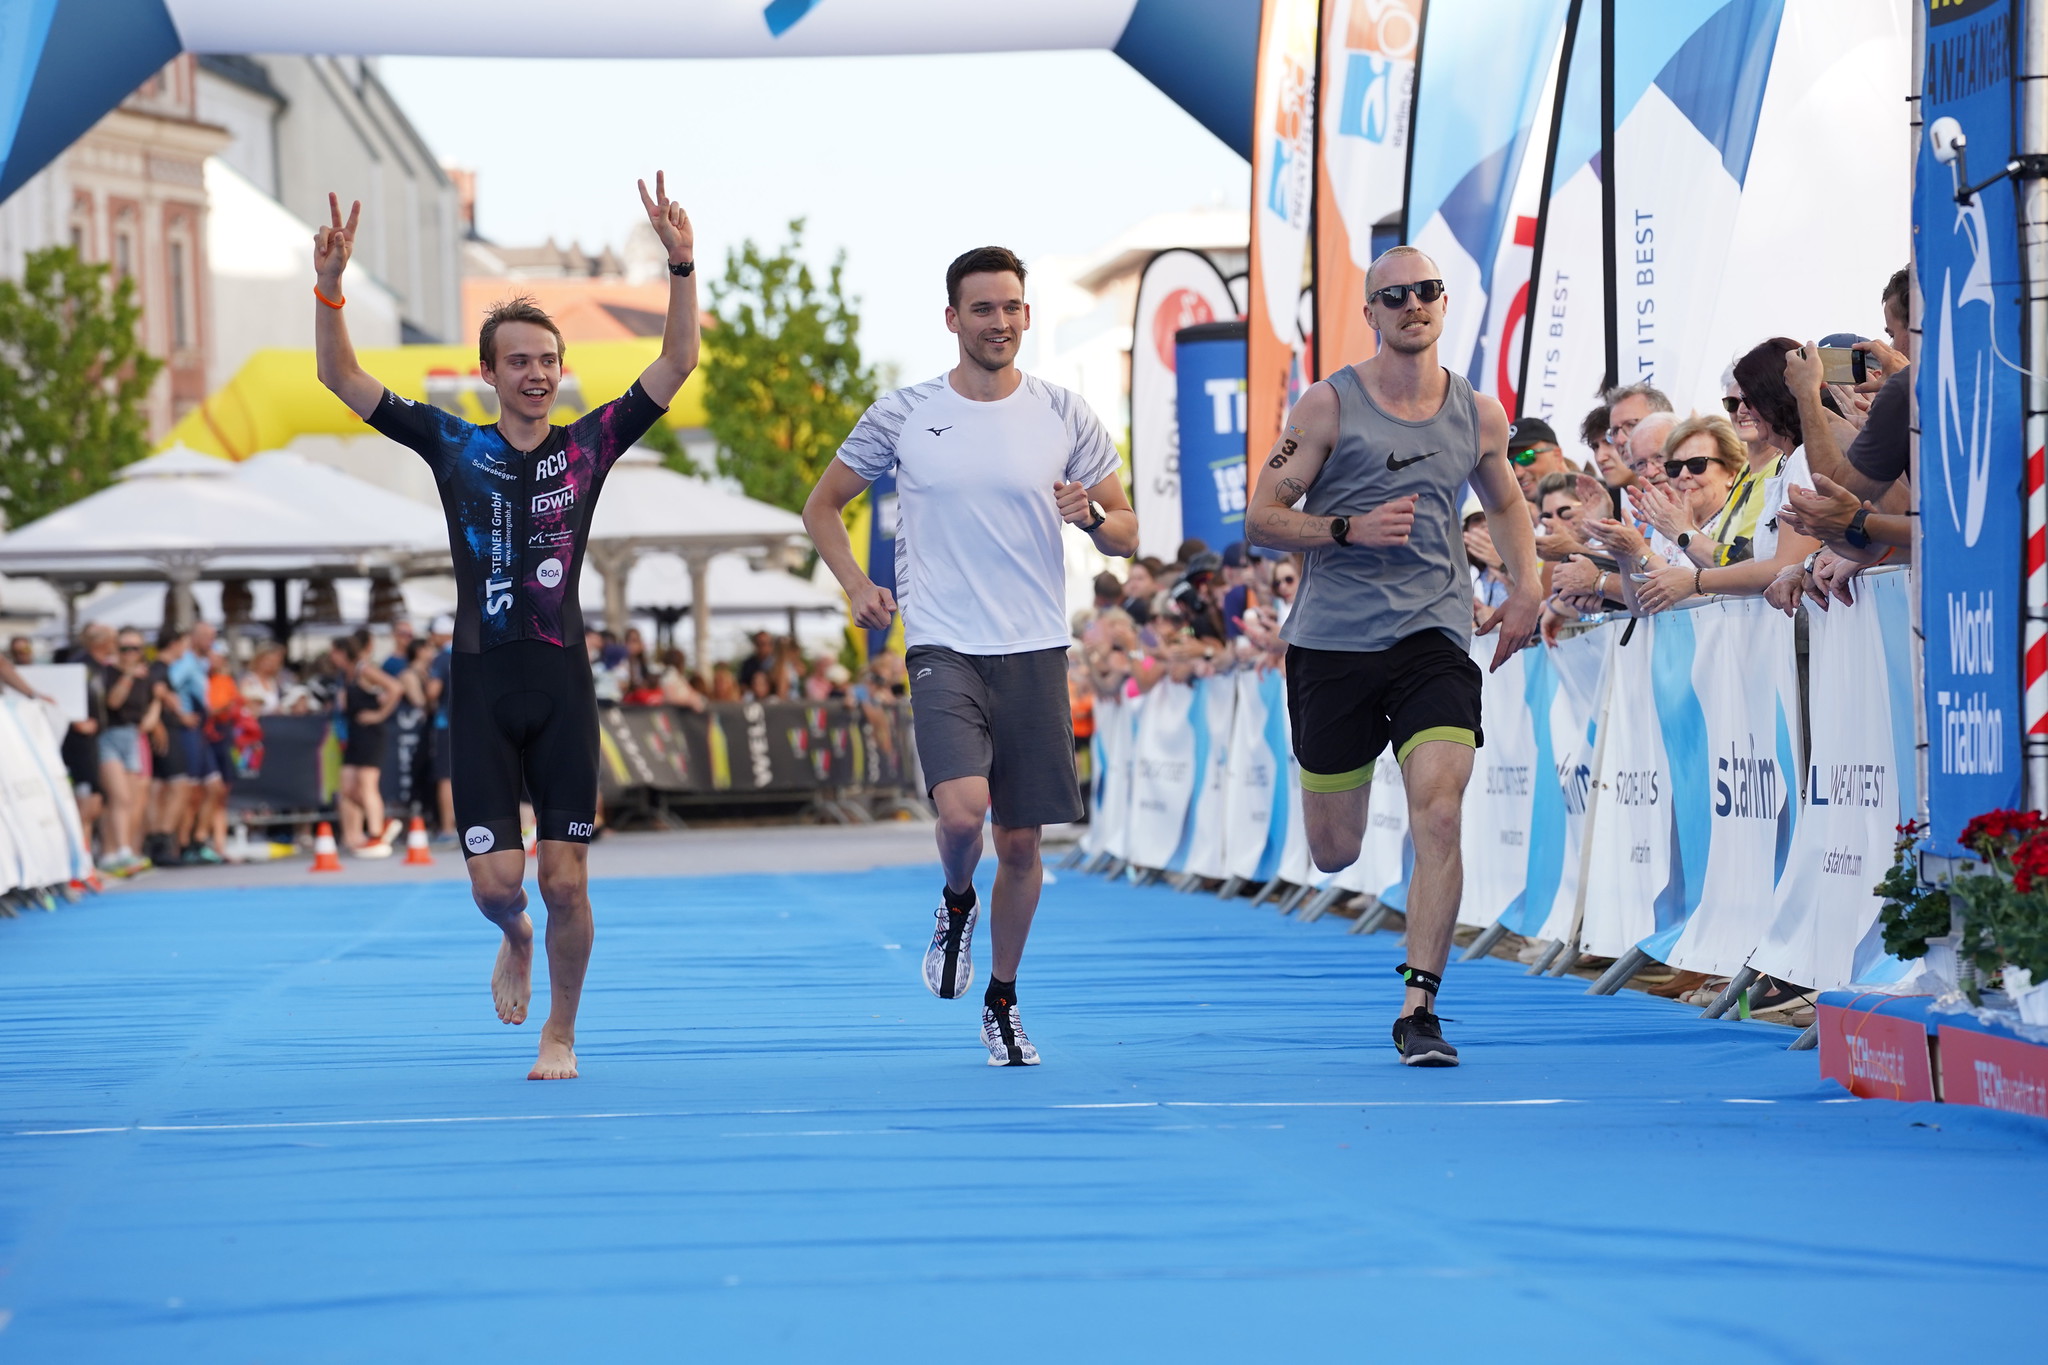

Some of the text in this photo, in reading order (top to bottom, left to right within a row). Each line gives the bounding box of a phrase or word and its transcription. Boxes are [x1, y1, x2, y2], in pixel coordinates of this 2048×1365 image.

[1635, 208, 1655, 286] BEST
[1549, 269, 1570, 338] BEST
[1637, 298, 1655, 345] ITS
[1543, 348, 1560, 389] ITS
[471, 458, 518, 481] Schwabegger
[535, 450, 568, 482] RCO
[486, 491, 514, 616] ST STEINER GmbH
[505, 501, 513, 567] www.steinergmbh.at
[540, 569, 560, 578] BOA
[1947, 590, 1994, 675] World
[1937, 691, 2003, 775] Triathlon
[1715, 732, 1777, 820] starlim
[468, 834, 490, 846] BOA
[568, 821, 593, 837] RCO
